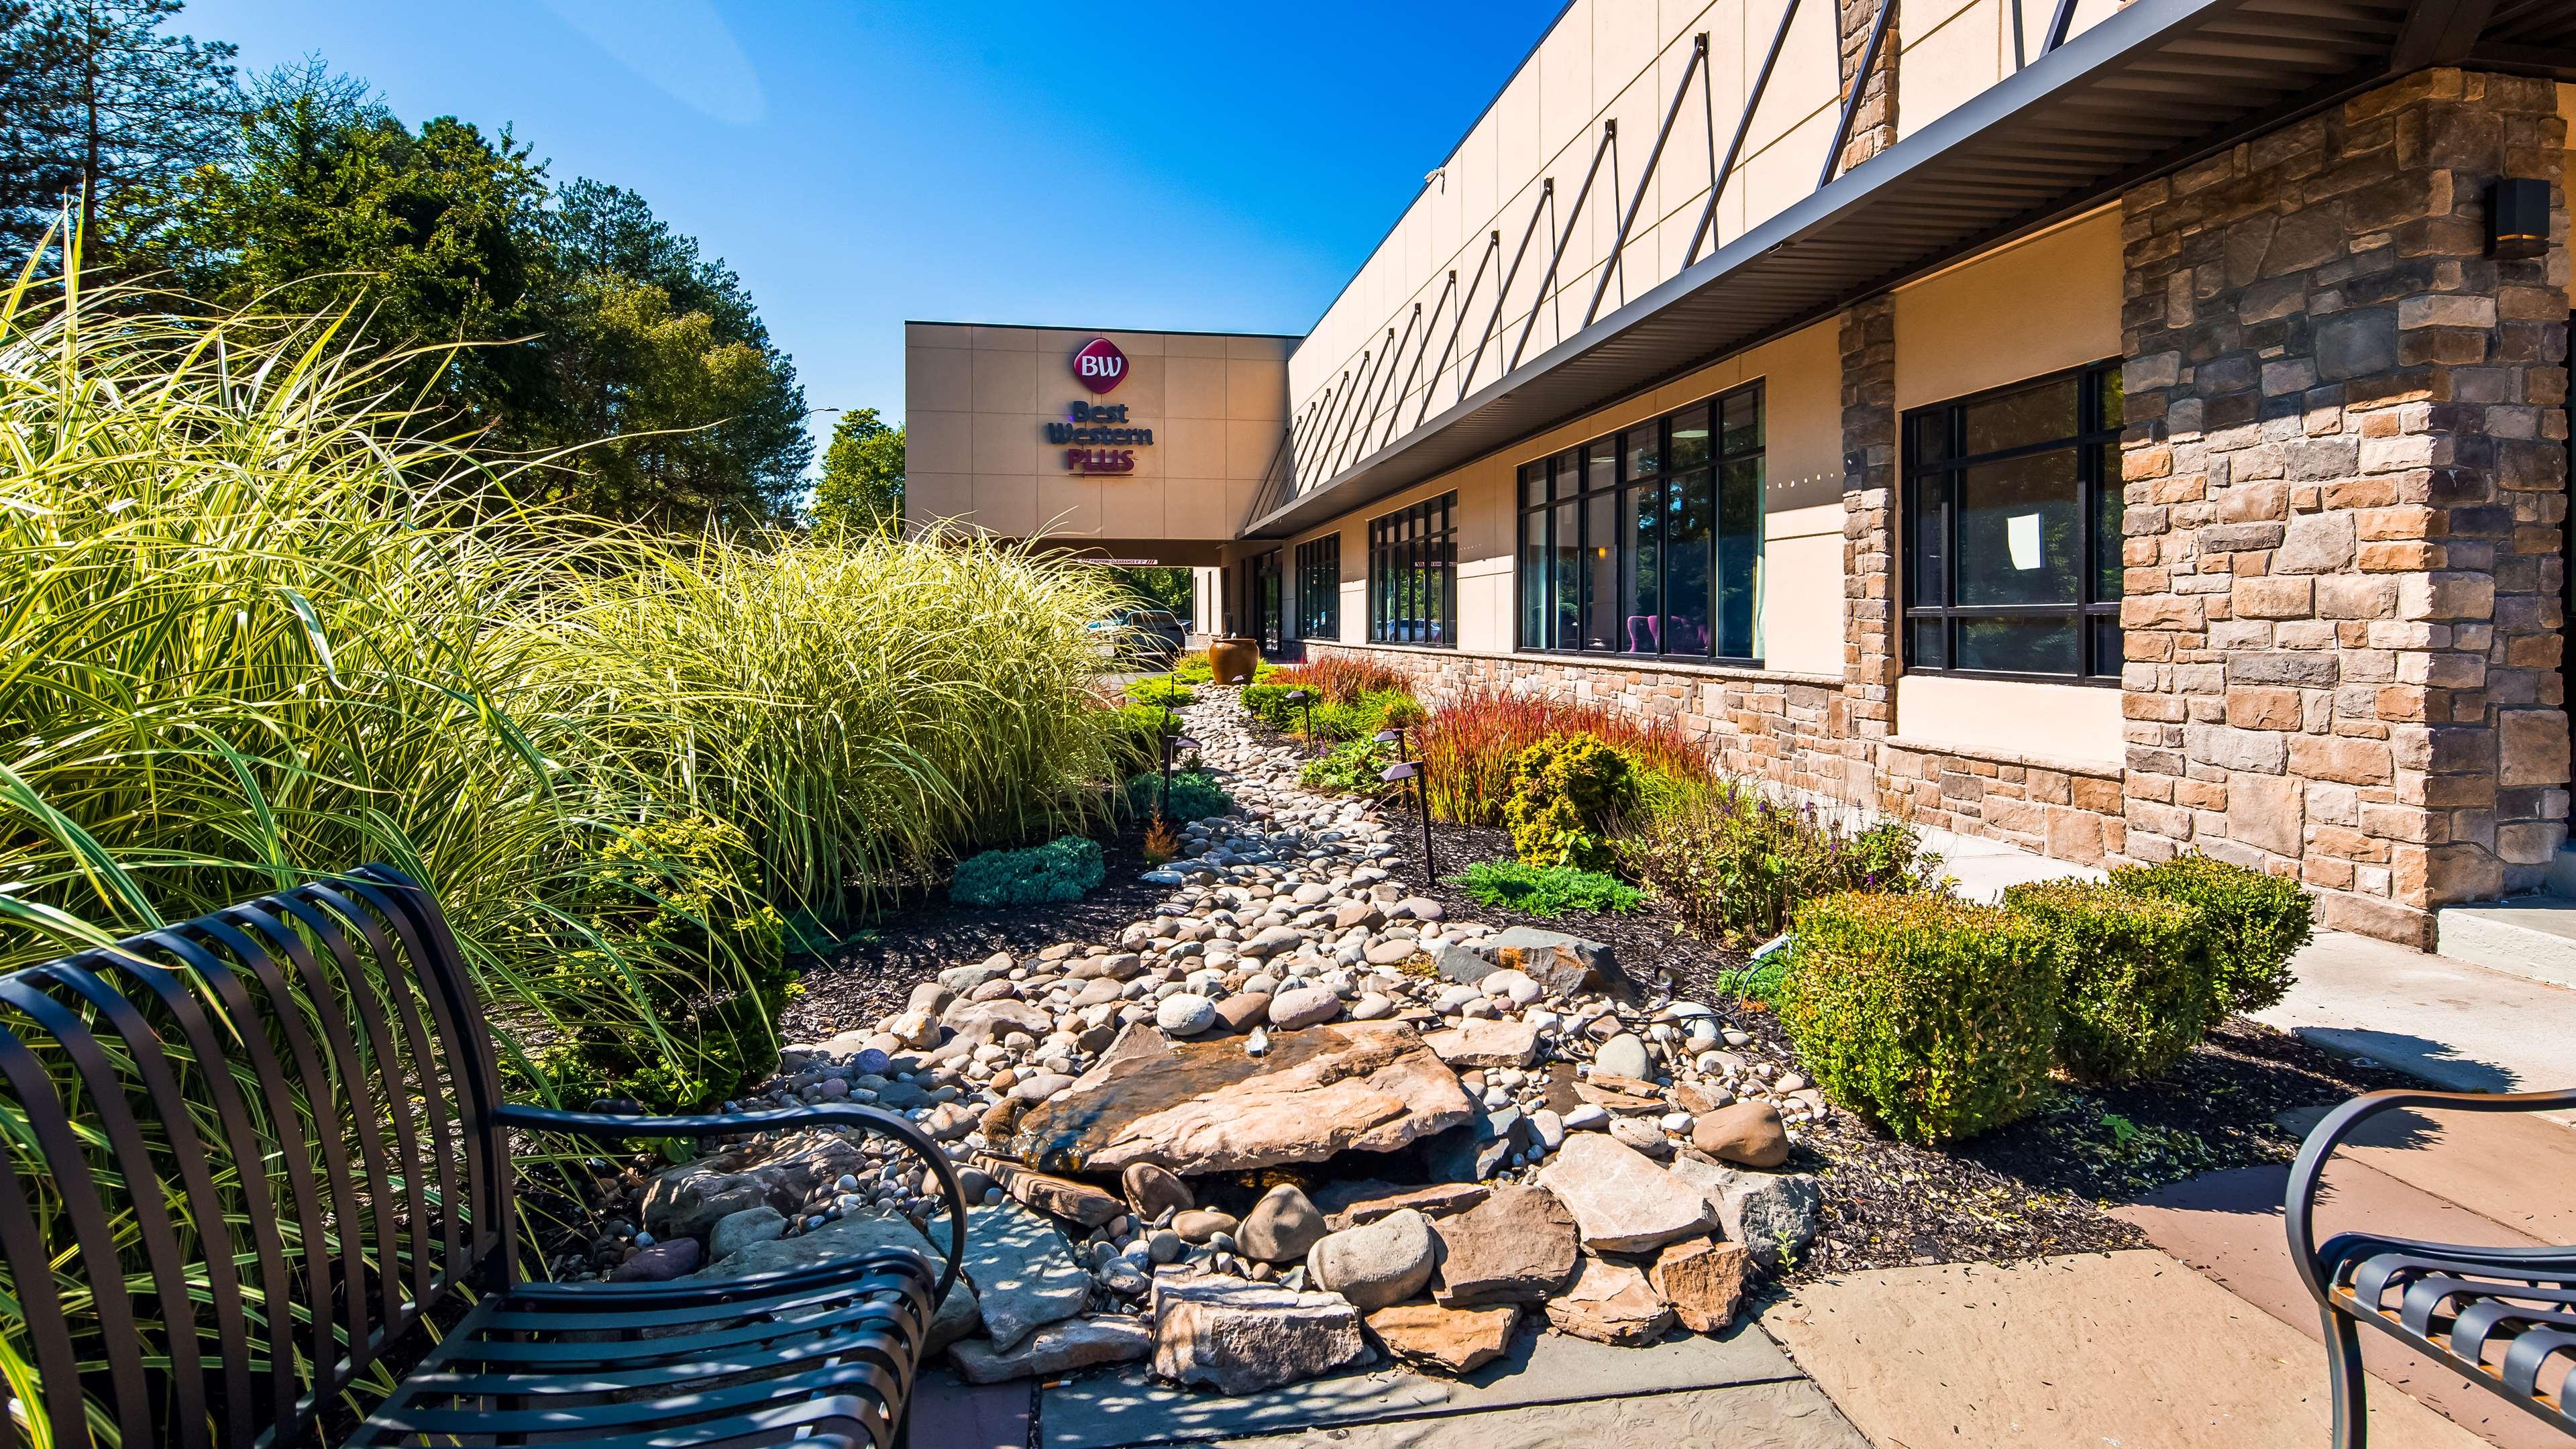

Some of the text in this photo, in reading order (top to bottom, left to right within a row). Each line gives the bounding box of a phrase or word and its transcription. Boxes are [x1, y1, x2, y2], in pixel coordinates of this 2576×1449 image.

[1081, 356, 1121, 376] BW
[1073, 400, 1129, 423] Best
[1048, 423, 1154, 445] Western
[1068, 449, 1134, 470] PLUS
